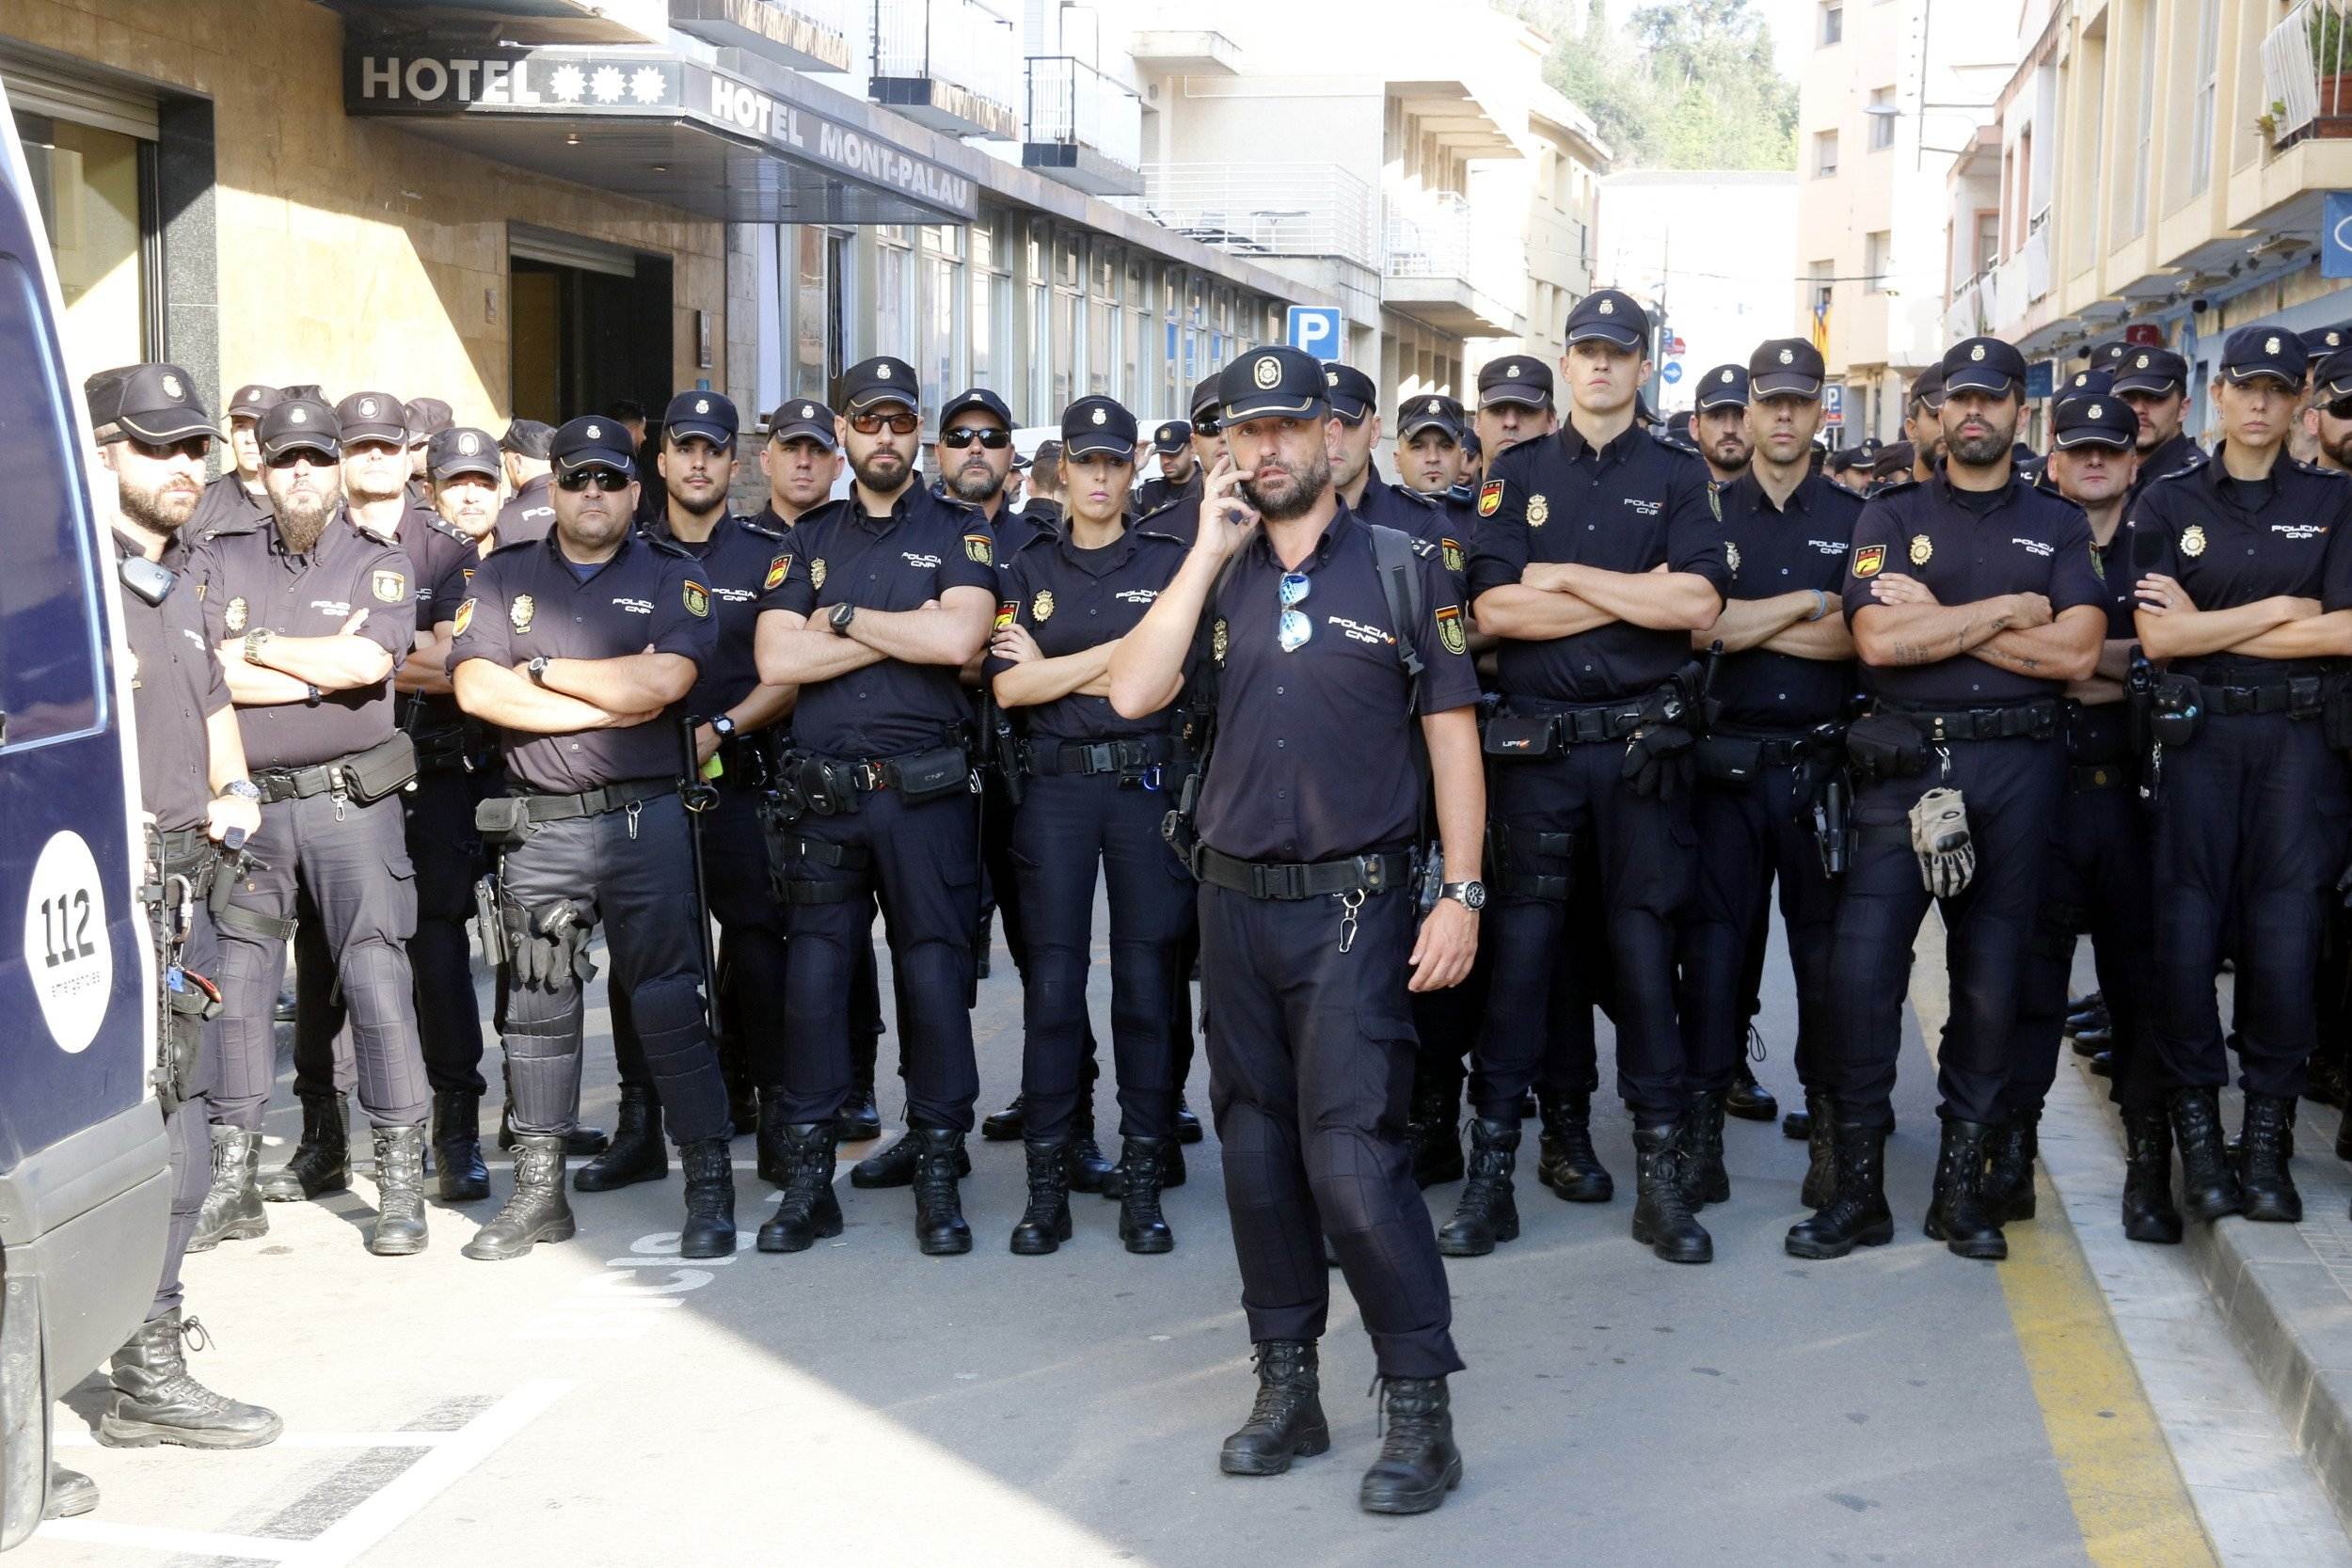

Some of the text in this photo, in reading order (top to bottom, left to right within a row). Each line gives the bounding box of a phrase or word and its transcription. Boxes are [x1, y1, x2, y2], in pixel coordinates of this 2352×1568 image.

[361, 56, 540, 104] HOTEL
[710, 76, 968, 209] HOTEL MONT-PALAU
[1297, 313, 1330, 353] P
[625, 605, 653, 614] CNP
[1327, 616, 1389, 641] POLICIA
[1344, 629, 1379, 645] CNP
[41, 888, 95, 968] 112
